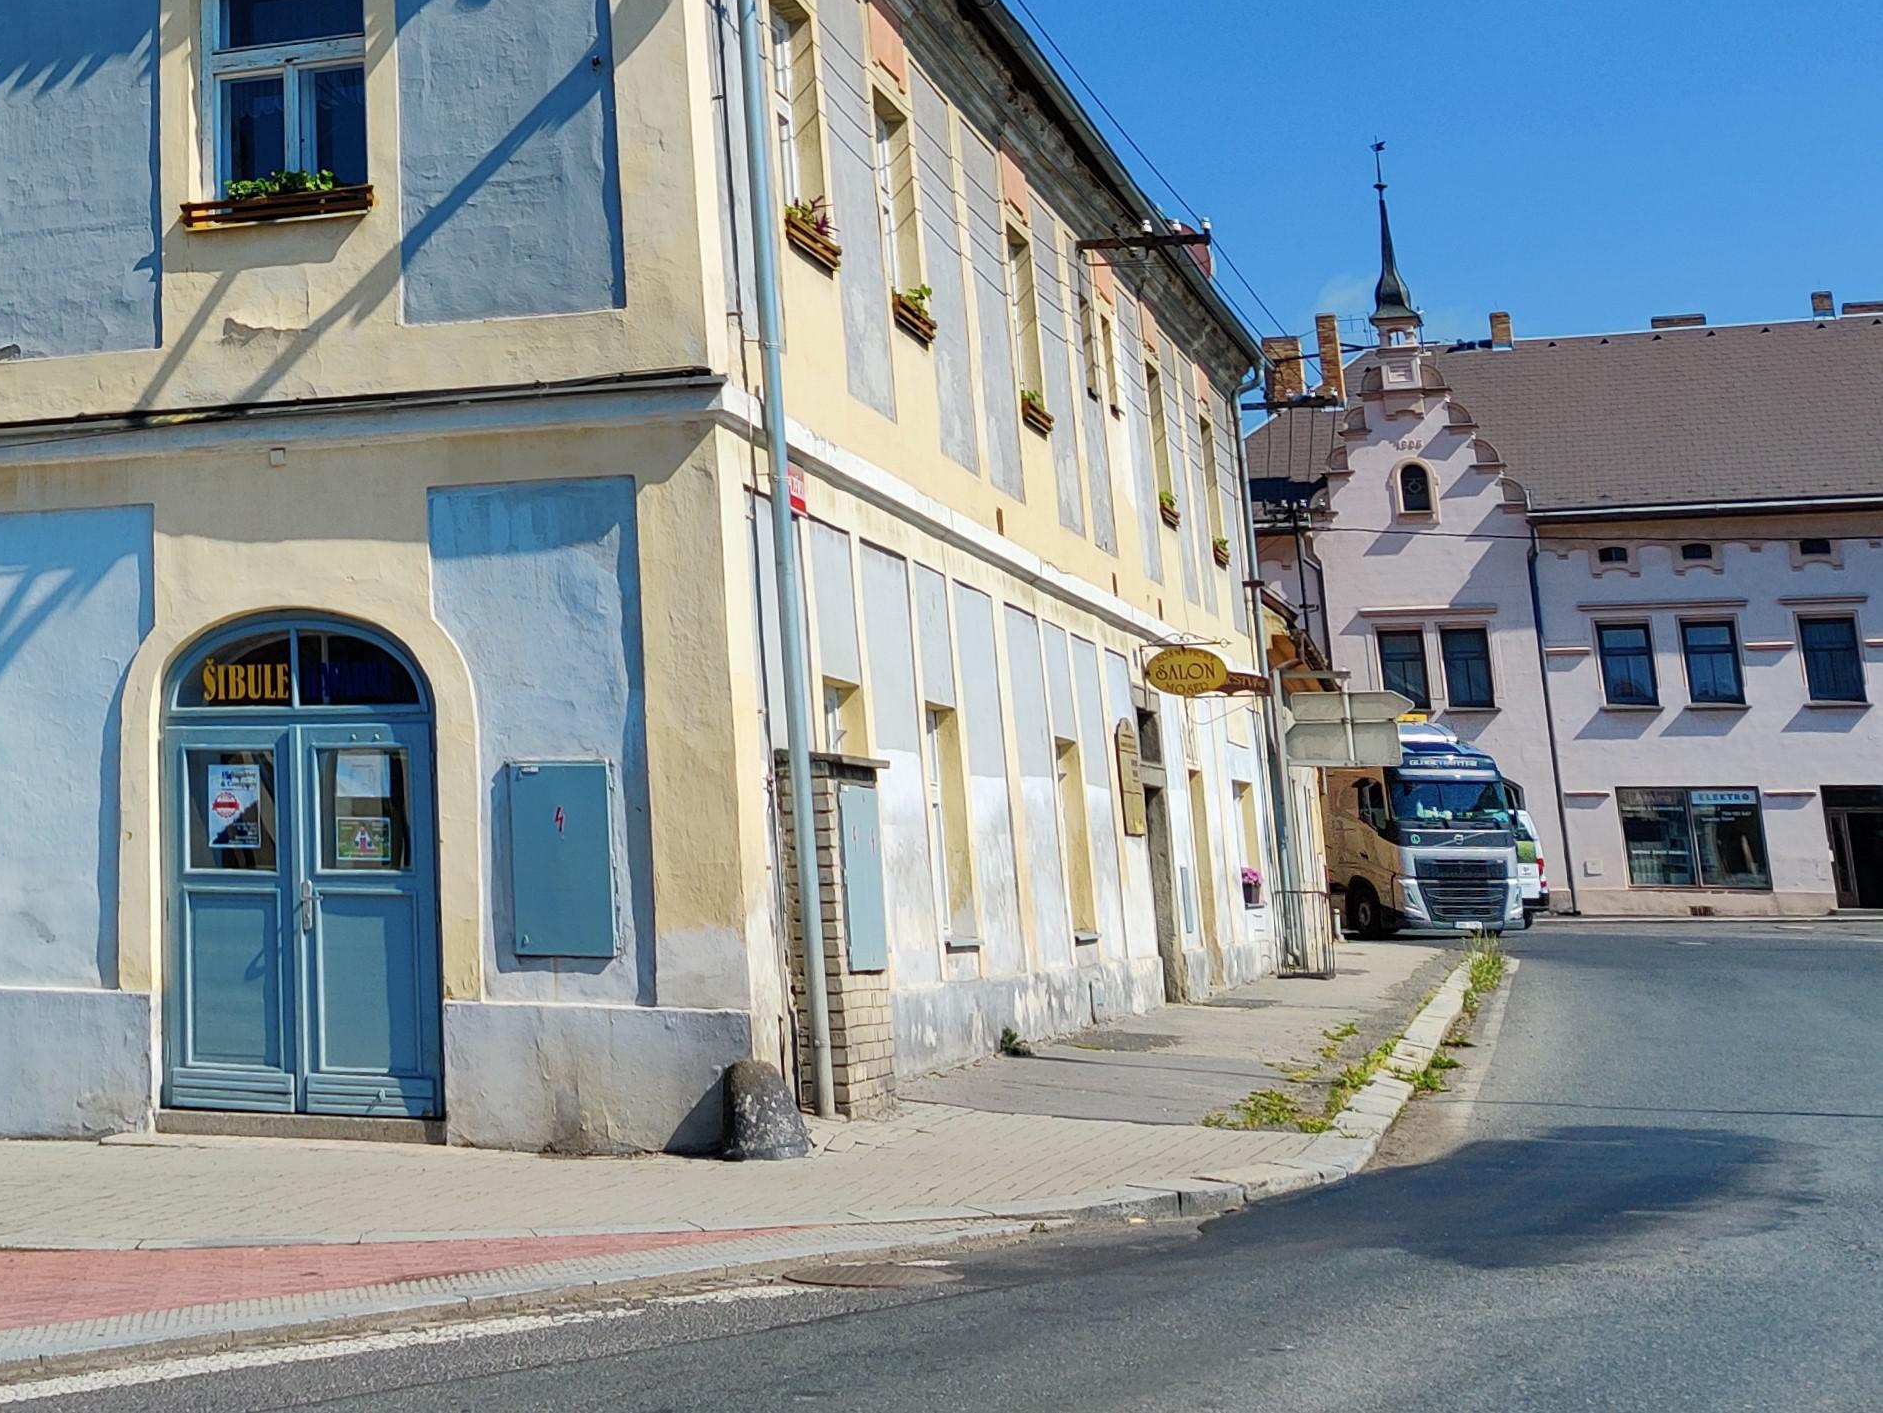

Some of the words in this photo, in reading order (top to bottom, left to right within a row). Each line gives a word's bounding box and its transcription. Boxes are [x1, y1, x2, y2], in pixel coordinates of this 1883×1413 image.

[202, 657, 290, 701] ŠIBULE
[1155, 662, 1216, 681] SALON
[1698, 793, 1750, 802] ELEKTRO
